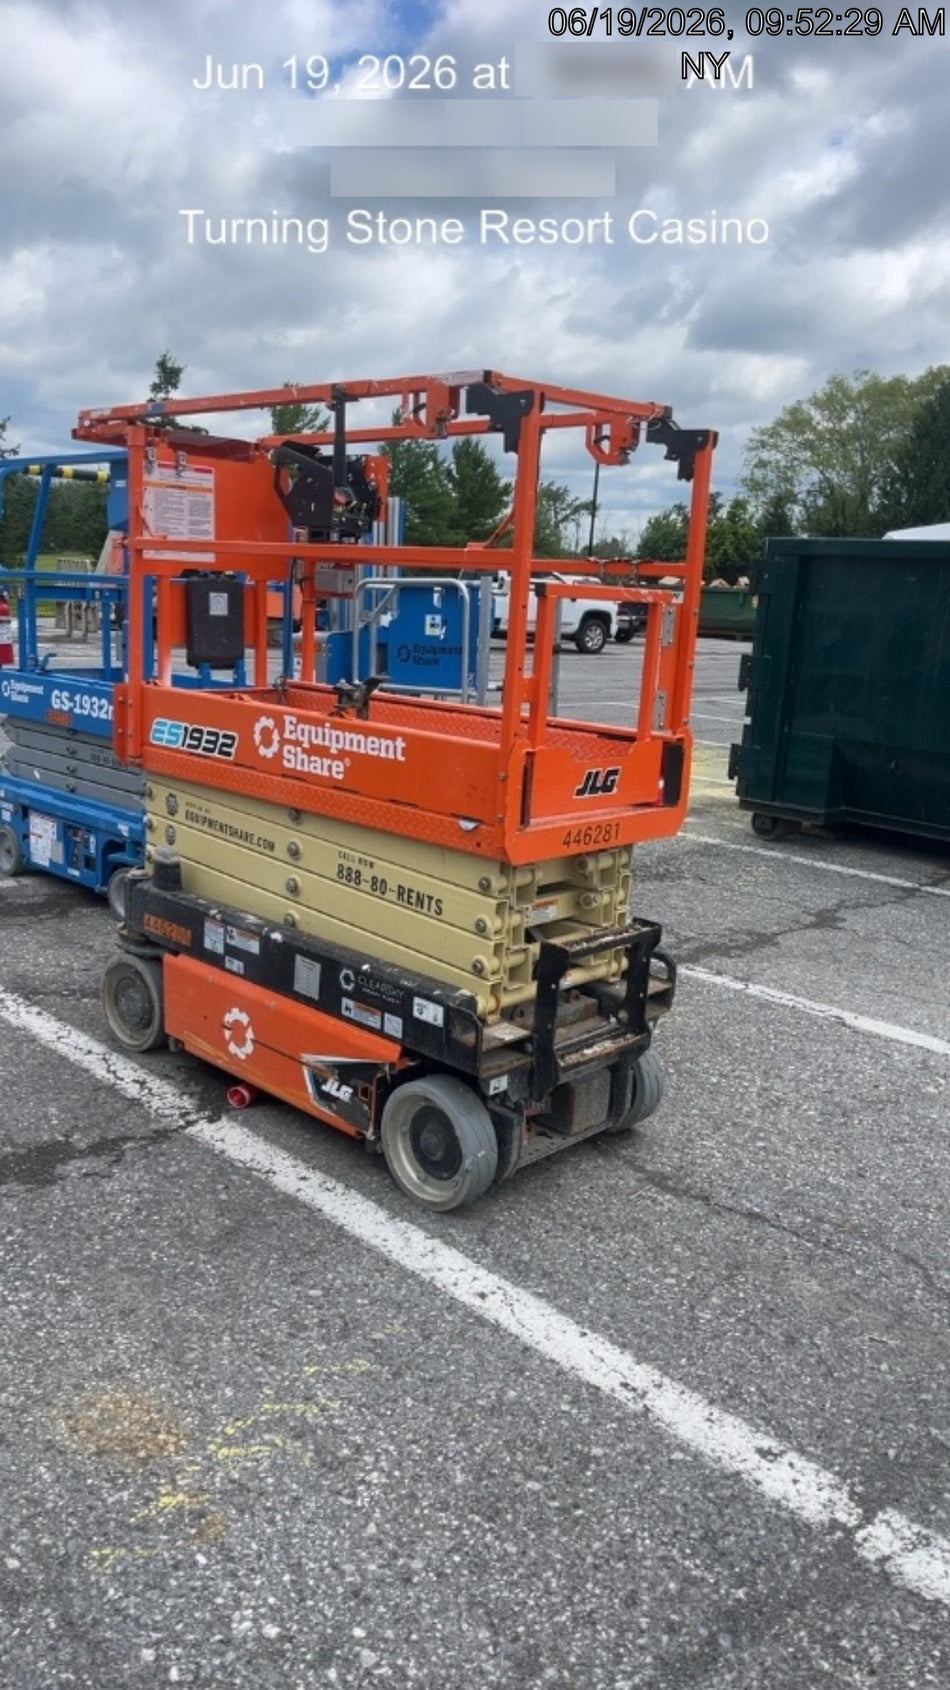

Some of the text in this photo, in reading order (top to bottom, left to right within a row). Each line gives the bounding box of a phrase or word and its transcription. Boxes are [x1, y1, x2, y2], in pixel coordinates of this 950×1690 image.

[151, 718, 238, 760] ES1932
[283, 715, 406, 761] Equipment
[283, 748, 345, 780] Share
[573, 767, 621, 798] JLG
[185, 809, 275, 852] EQUIPMENTSHARE.COM
[562, 822, 621, 849] 446281
[337, 863, 443, 916] 888-80-RENTS
[320, 1078, 353, 1102] JLG
